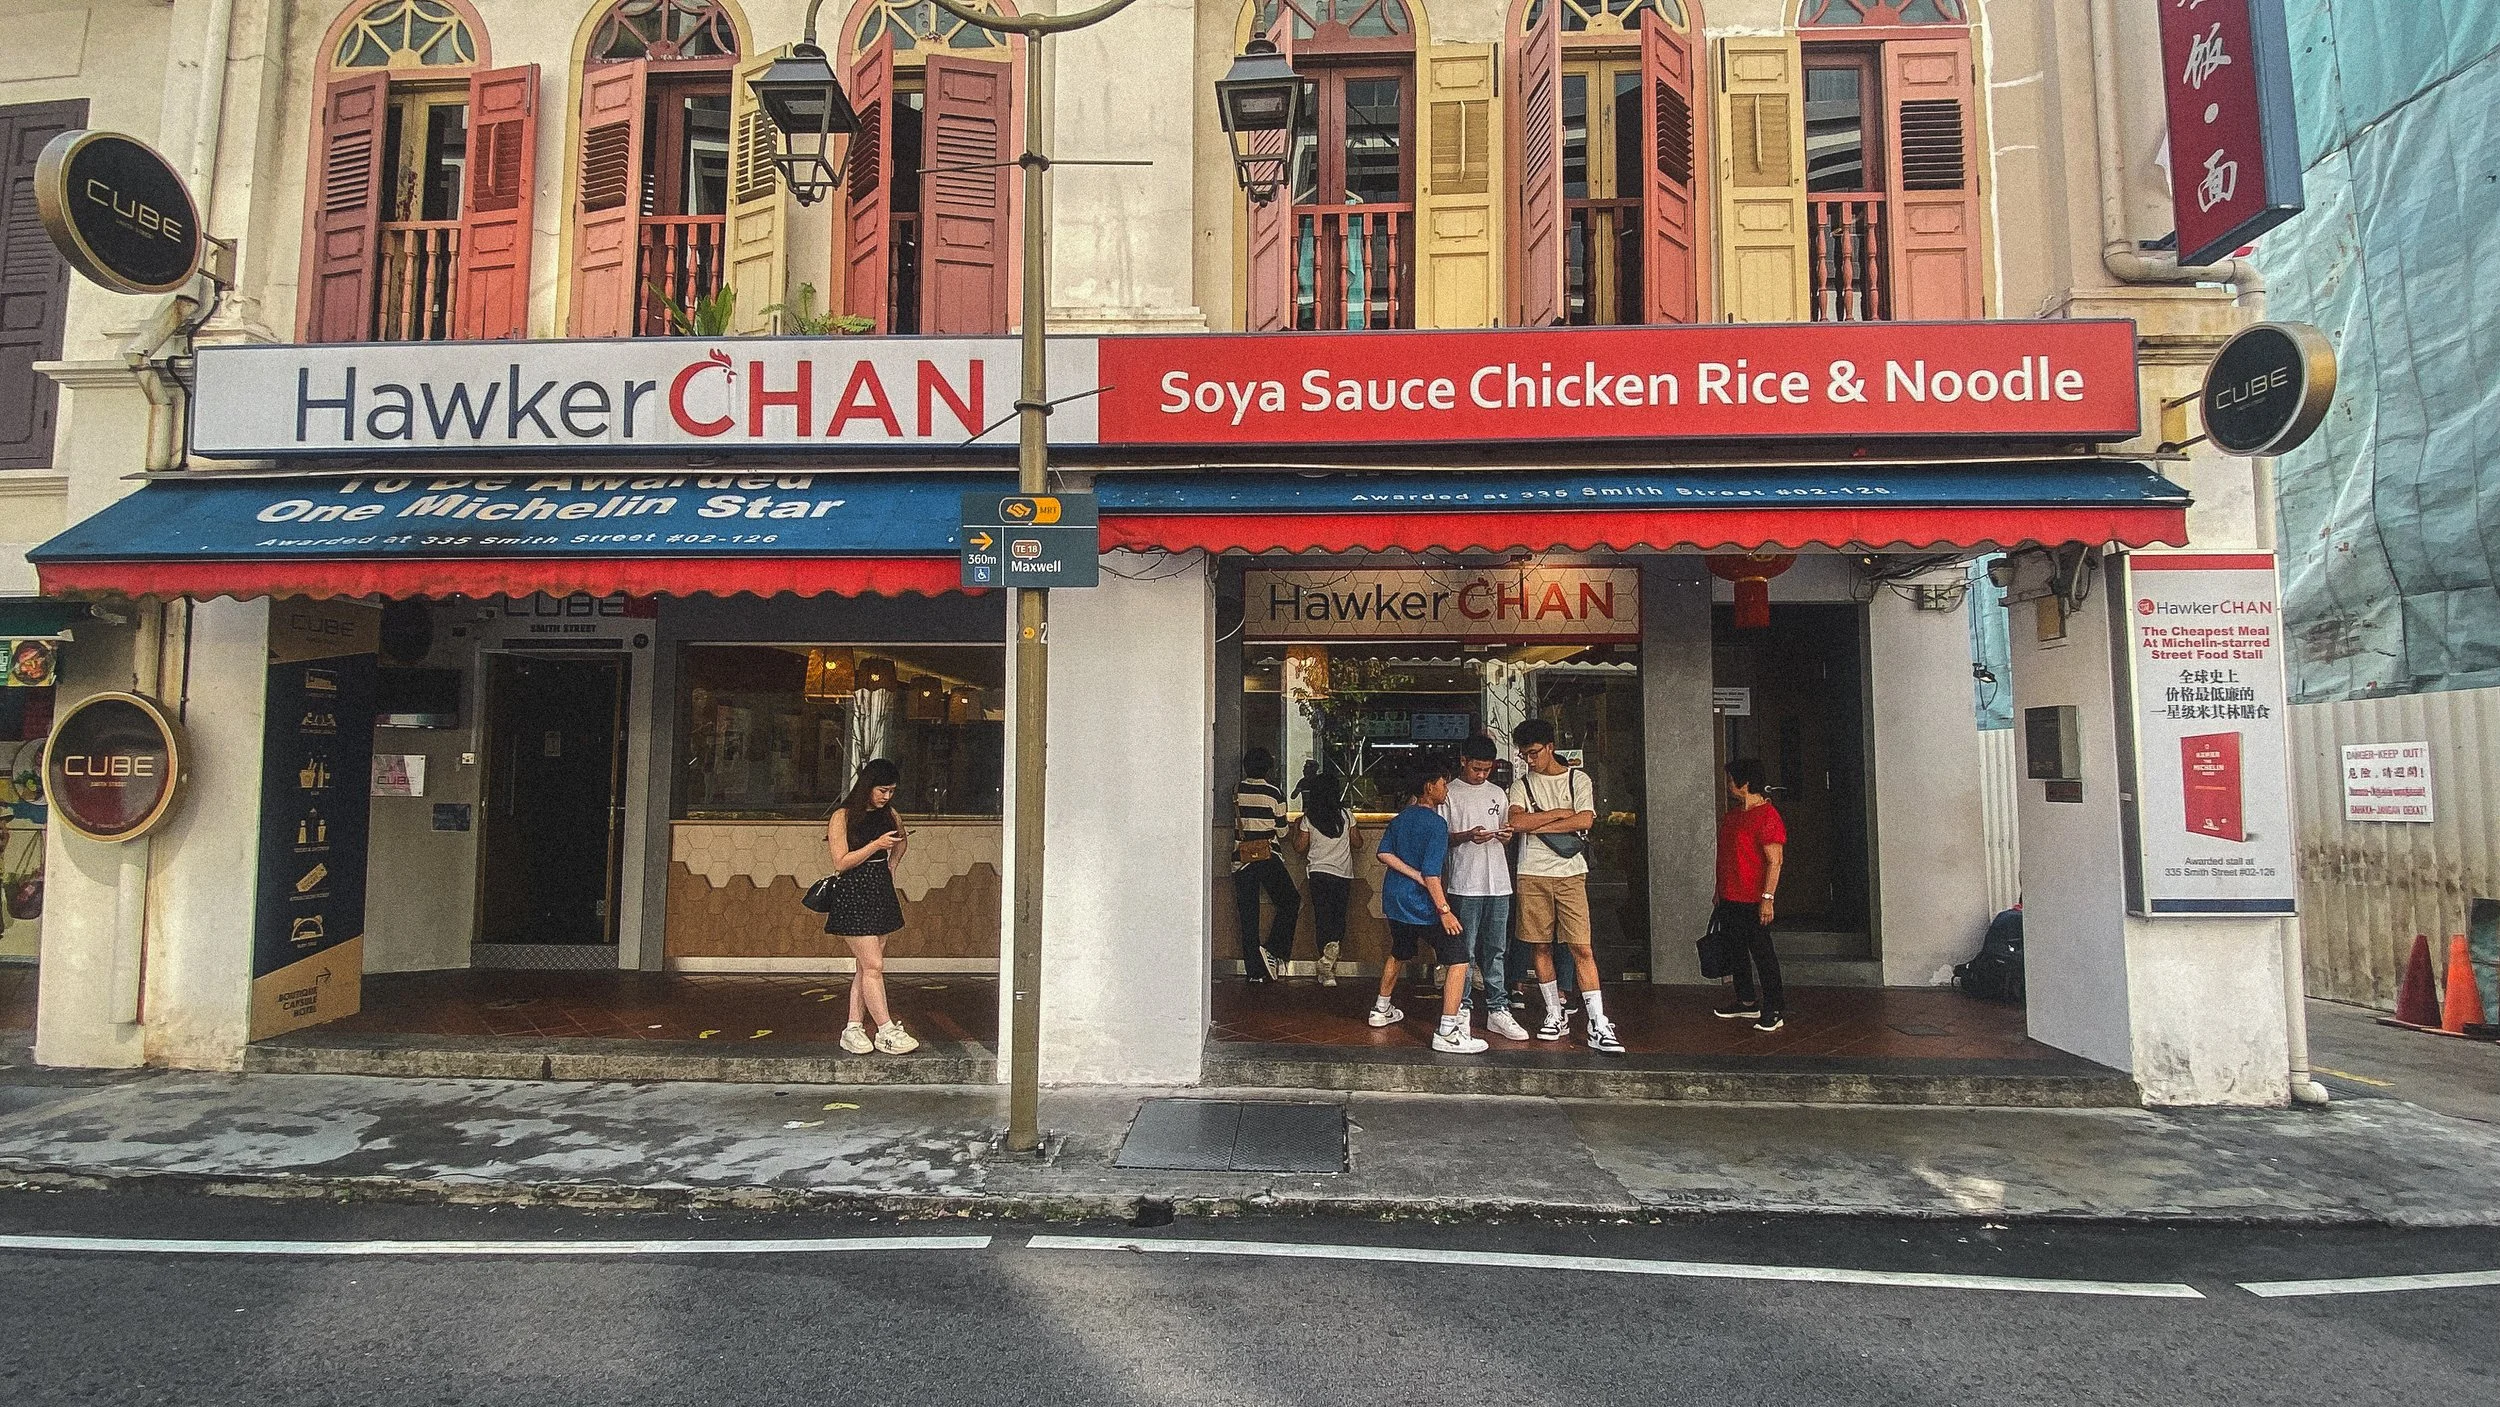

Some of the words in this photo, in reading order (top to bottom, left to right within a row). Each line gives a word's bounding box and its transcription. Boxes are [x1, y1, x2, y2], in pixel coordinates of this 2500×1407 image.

[87, 178, 183, 244] CUBE
[1160, 370, 1286, 426] Soya
[1301, 368, 1456, 413] Sauce
[1469, 361, 1679, 410] Chicken
[1698, 358, 1810, 405] Rice
[1826, 358, 1869, 403] &
[1885, 355, 2085, 404] Noodle
[2215, 366, 2289, 410] CUBE
[297, 349, 985, 443] HawkerCHAN
[1351, 492, 1470, 502] Awarded
[1483, 492, 1509, 500] at
[1520, 489, 1568, 499] 335
[1581, 486, 1664, 499] Smith
[1676, 486, 1766, 498] Street
[256, 499, 386, 523] One
[396, 494, 679, 521] Michelin
[697, 494, 846, 519] Star
[1039, 505, 1058, 514] MRT
[255, 535, 377, 547] Awarded
[383, 534, 409, 545] at
[420, 535, 472, 545] 335
[479, 534, 559, 545] Smith
[570, 531, 657, 545] Street
[665, 533, 779, 545] #02-126
[1015, 545, 1027, 554] TE
[1028, 545, 1038, 554] 18
[968, 554, 997, 565] 360m
[1011, 560, 1062, 573] Maxwell
[1269, 577, 1615, 622] HawkerCHAN
[2156, 600, 2272, 615] HawkerCHAN
[291, 614, 355, 638] CUBE
[530, 624, 561, 633] SMITH
[563, 624, 597, 633] STREET
[2142, 626, 2168, 636] The
[2171, 626, 2234, 638] Cheapest
[2238, 626, 2270, 636] Meal
[2142, 638, 2159, 648] At
[2162, 637, 2270, 648] Michelin-starred
[2151, 649, 2193, 660] Street
[2196, 650, 2229, 660] Food
[2233, 649, 2264, 660] Stall
[2179, 669, 2240, 684] 全球史上
[2165, 686, 2255, 702] 价格最低廉的
[2149, 703, 2271, 720] 一星级米其林膳食
[64, 755, 155, 777] CUBE
[2184, 857, 2224, 867] Awarded
[2225, 857, 2244, 867] stall
[2245, 858, 2255, 867] at
[2164, 868, 2182, 877] 335
[2183, 868, 2210, 877] Smith
[2210, 868, 2238, 877] Street
[2239, 868, 2276, 877] #02-126
